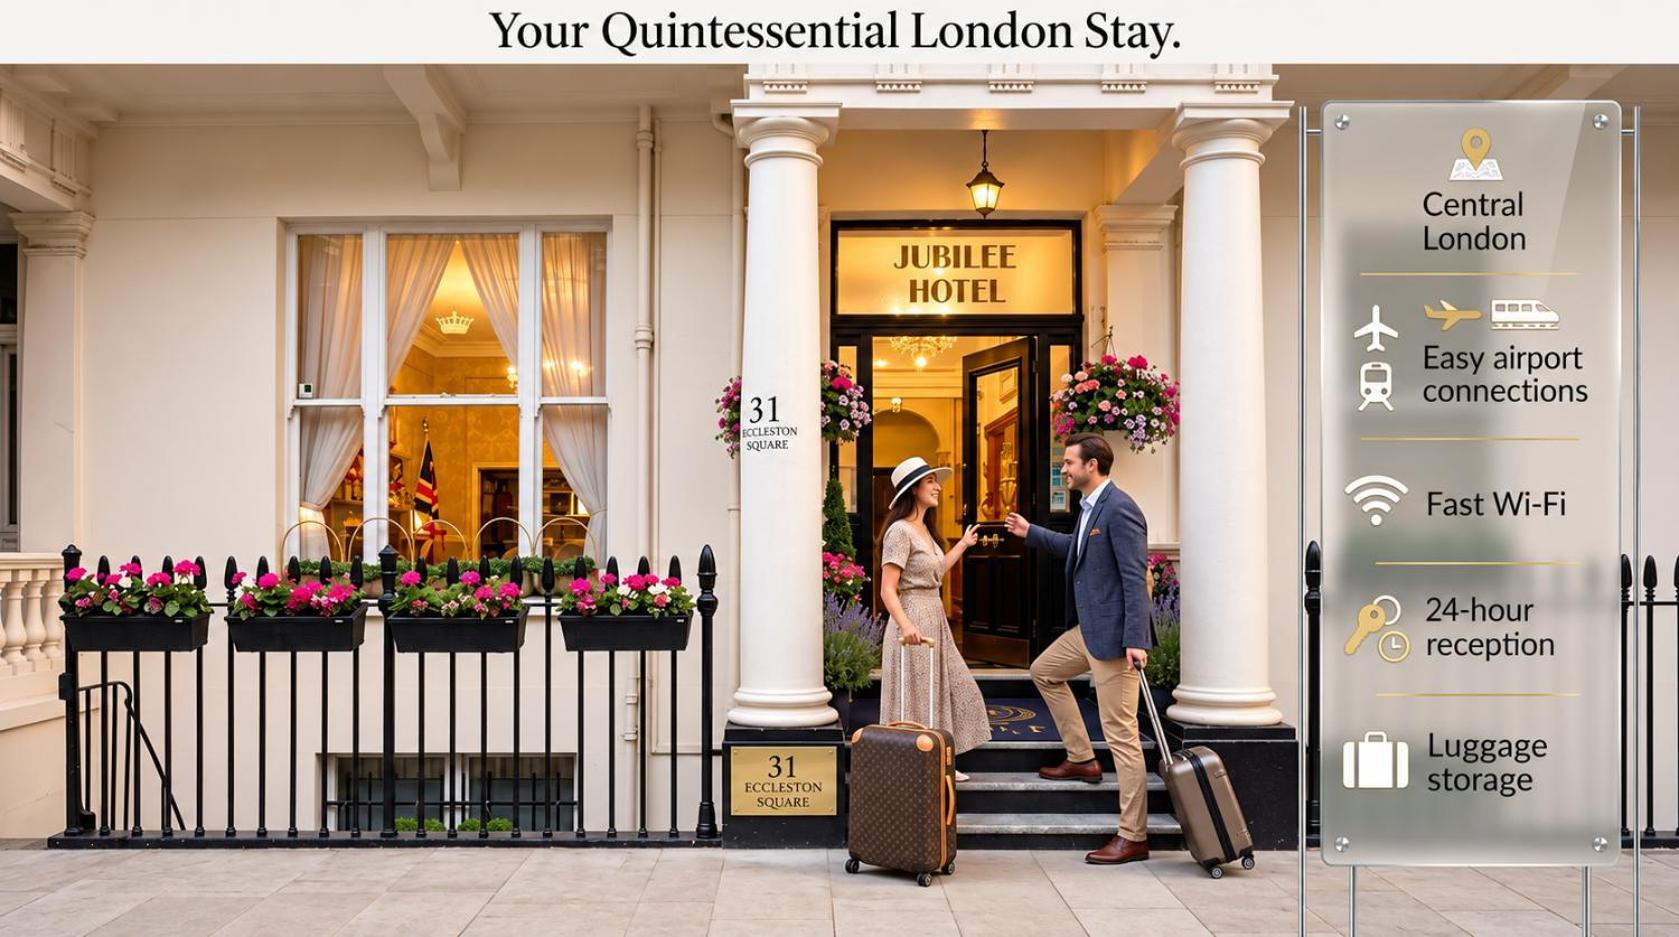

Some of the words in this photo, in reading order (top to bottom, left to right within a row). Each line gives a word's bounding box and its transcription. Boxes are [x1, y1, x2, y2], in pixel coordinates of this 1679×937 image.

[1423, 191, 1523, 217] Central
[1424, 225, 1526, 251] London
[893, 244, 1017, 269] JUBILEE
[909, 279, 1007, 303] HOTEL
[1424, 345, 1485, 375] Easy
[1493, 345, 1583, 375] airport
[1423, 378, 1588, 403] connections
[749, 396, 780, 424] 31
[742, 426, 798, 438] ECCLESTON
[746, 439, 789, 452] SQUARE
[1428, 491, 1484, 516] Fast
[1492, 491, 1566, 516] Wi-Fi
[1426, 596, 1534, 622] 24-hour
[1427, 631, 1554, 662] reception
[1429, 732, 1548, 764] Luggage
[768, 755, 796, 778] 31
[745, 782, 822, 793] ECCLESTON
[1428, 768, 1533, 798] storage
[757, 796, 810, 810] SQUARE
